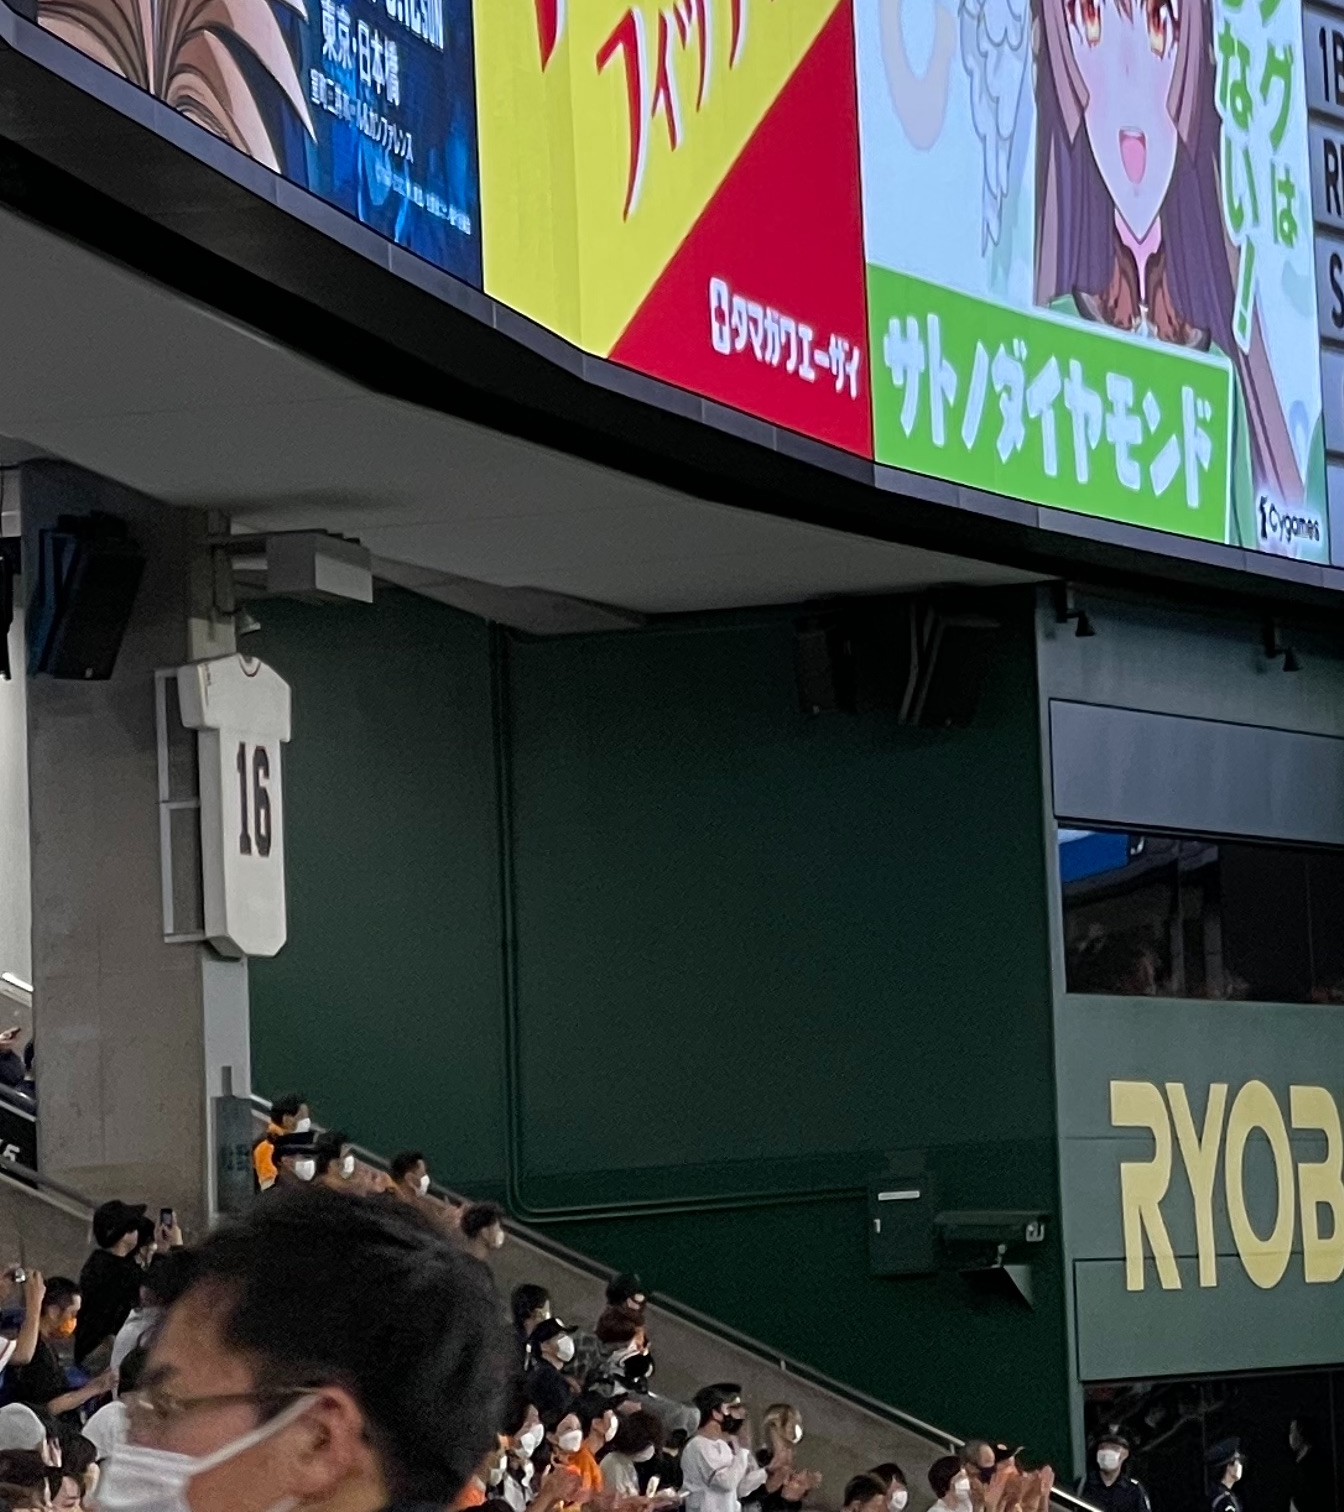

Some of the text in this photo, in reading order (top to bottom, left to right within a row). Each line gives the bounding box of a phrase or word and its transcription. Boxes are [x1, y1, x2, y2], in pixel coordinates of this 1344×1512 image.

[728, 296, 860, 399] タマガワエーザイ
[883, 313, 1213, 510] サトノダイヤモンド
[1268, 502, 1320, 544] Cygames
[236, 741, 272, 858] 16
